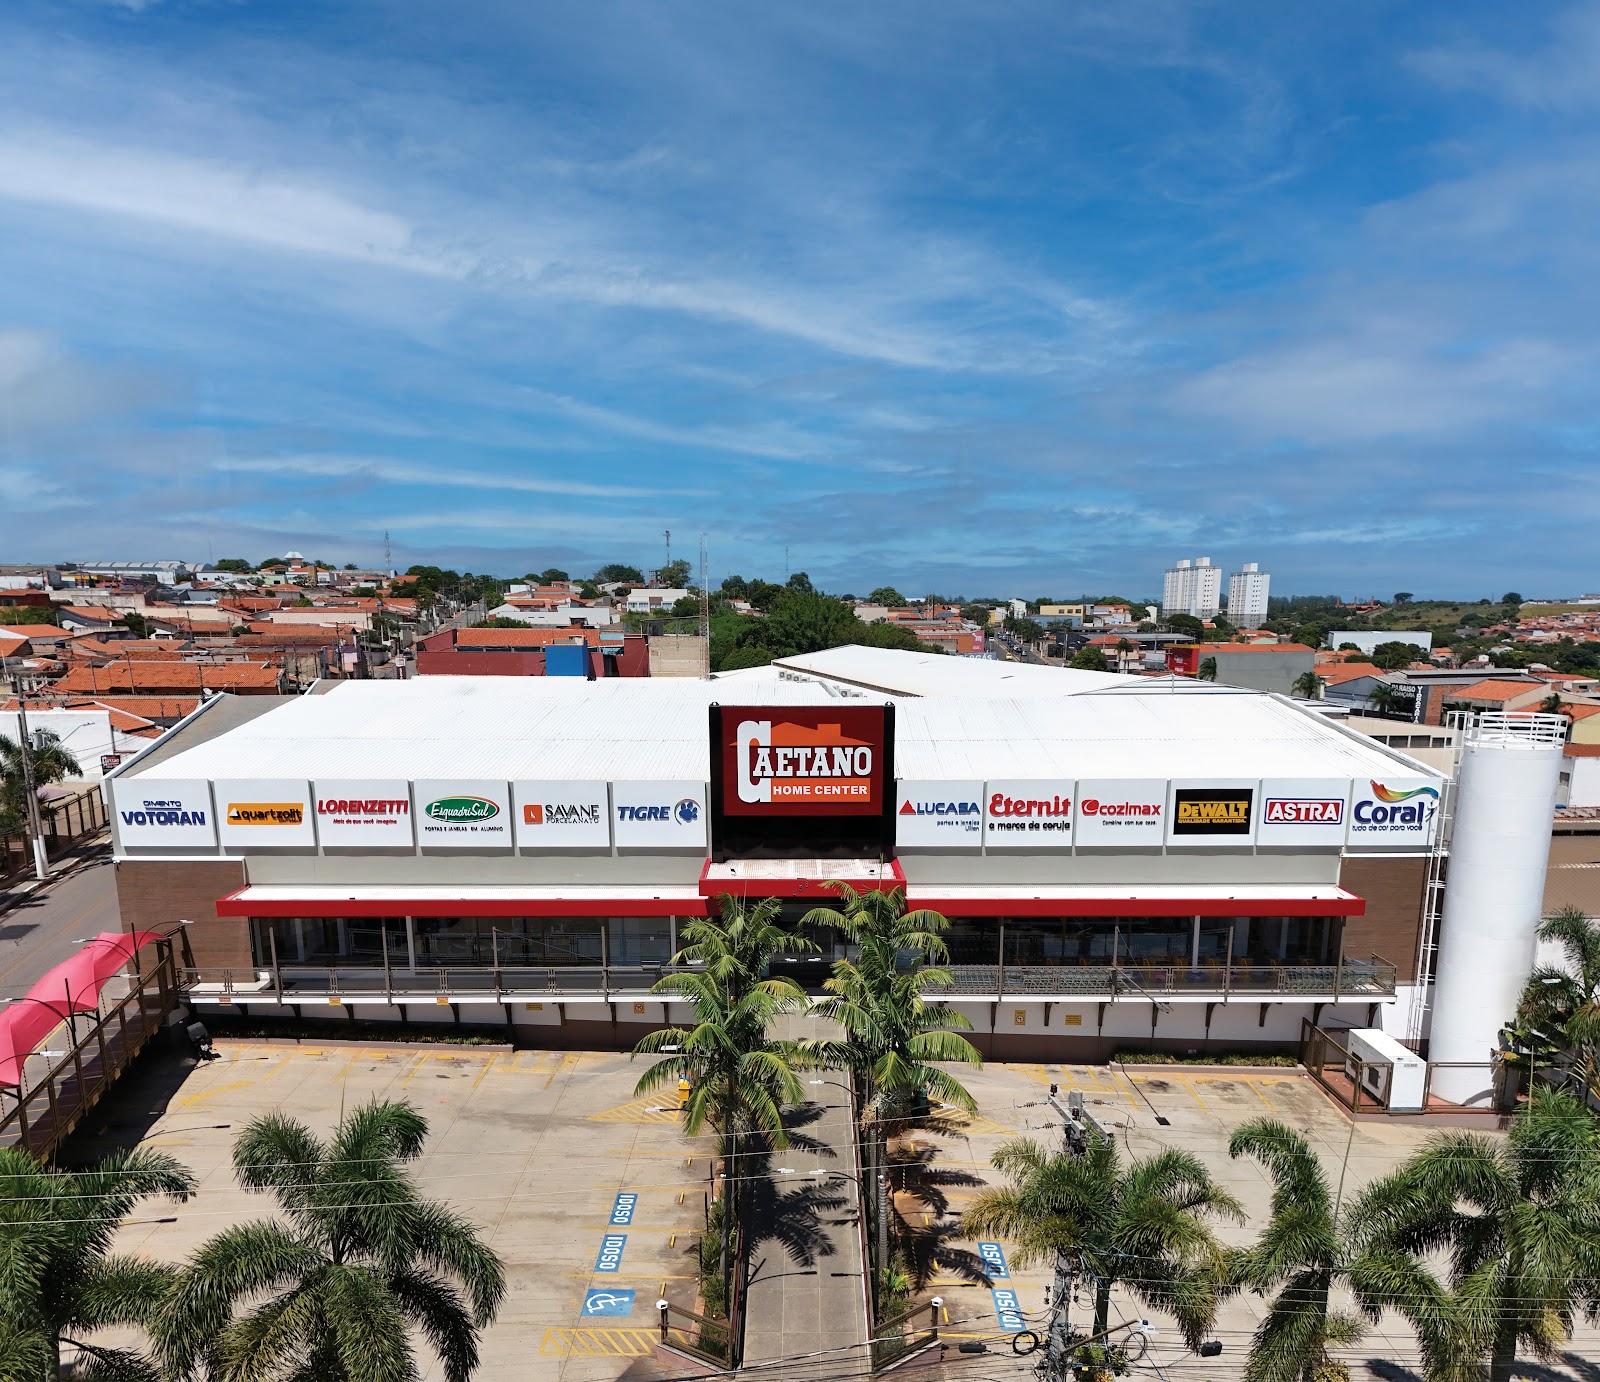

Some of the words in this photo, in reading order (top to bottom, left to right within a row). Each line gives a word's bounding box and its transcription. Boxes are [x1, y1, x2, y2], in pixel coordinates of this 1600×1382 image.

[737, 720, 872, 803] GAETANO
[773, 786, 811, 795] HOME
[814, 786, 868, 795] CENTER
[318, 800, 408, 814] LORENZETTI
[431, 802, 489, 820] EsquadriSul
[545, 804, 600, 819] SAVANE
[989, 794, 1071, 816] Eternit
[1100, 802, 1161, 816] cozimax
[1268, 803, 1338, 820] ASTRA
[1354, 800, 1424, 824] Coral
[121, 812, 206, 825] VOTORAN
[242, 808, 302, 822] quartzolit
[618, 806, 670, 820] TIGRE
[1028, 821, 1040, 830] da
[1042, 820, 1070, 832] coruja
[613, 1194, 635, 1223] IDOSO
[600, 1236, 623, 1269] IDOSO
